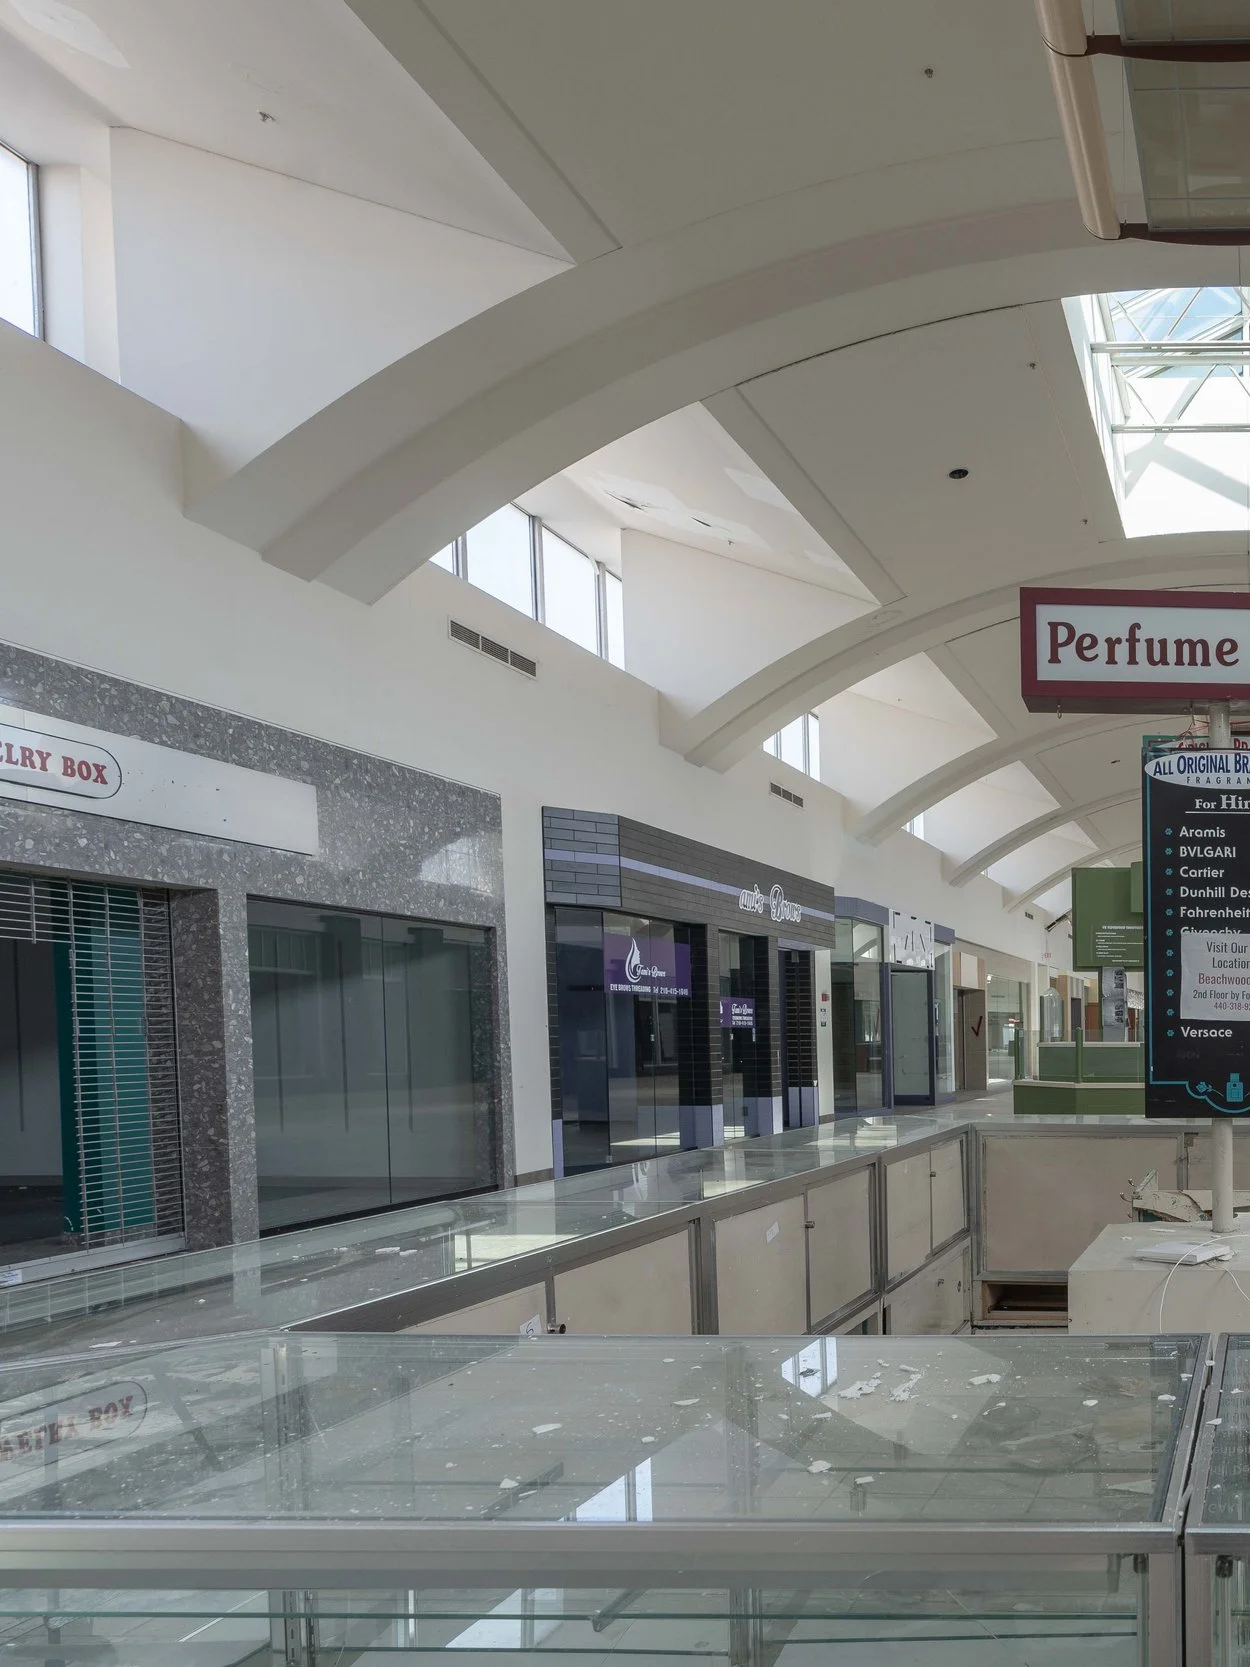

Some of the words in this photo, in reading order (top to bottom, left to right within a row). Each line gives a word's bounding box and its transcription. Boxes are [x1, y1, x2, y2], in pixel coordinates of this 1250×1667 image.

[1047, 621, 1239, 667] Perfume
[0, 741, 52, 772] LRY
[62, 755, 108, 785] BOX
[1153, 760, 1174, 776] ALL
[1176, 754, 1231, 774] ORIGINAL
[1195, 799, 1216, 809] For
[1179, 826, 1226, 838] Aramis
[1179, 846, 1236, 858] BVLGARI
[1179, 866, 1225, 878] Cartier
[1180, 886, 1225, 898] Dunhill
[1180, 907, 1250, 918] Fahrenheit
[1206, 941, 1228, 953] Visit
[1231, 942, 1248, 954] Our
[1192, 989, 1207, 999] 2nd
[1209, 990, 1228, 999] Floor
[1230, 990, 1240, 1001] by
[1180, 1026, 1233, 1037] Versace
